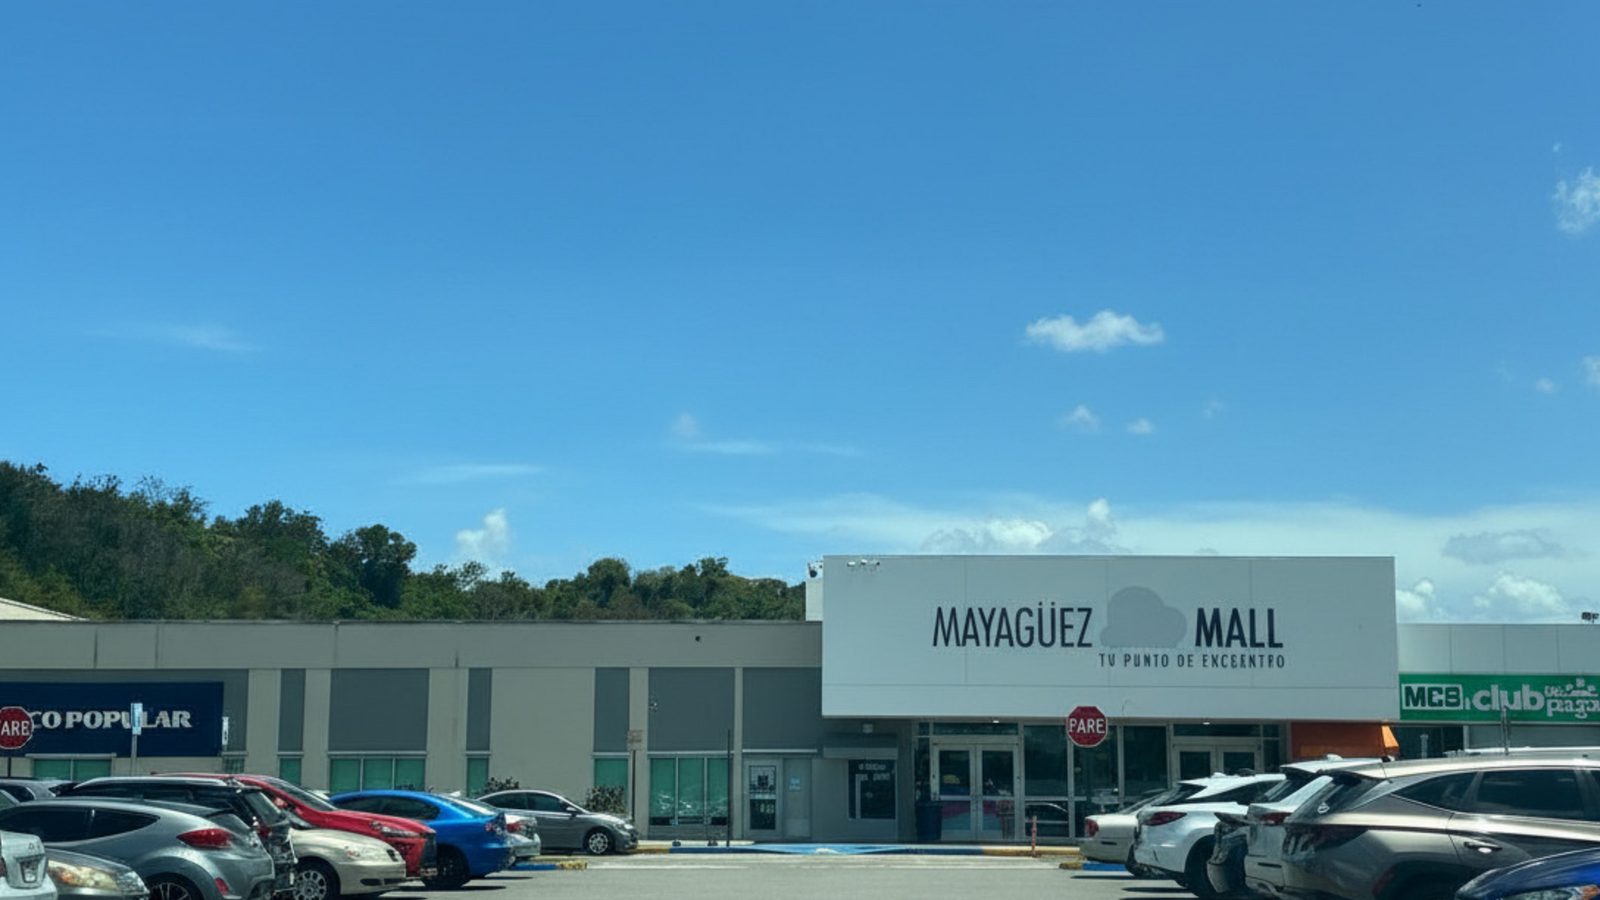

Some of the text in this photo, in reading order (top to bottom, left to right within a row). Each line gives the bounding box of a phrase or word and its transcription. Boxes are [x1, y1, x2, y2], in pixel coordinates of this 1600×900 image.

[932, 601, 1284, 648] MAYAGÜEZ MALL
[1124, 653, 1169, 668] PUNTO
[1472, 684, 1545, 711] club
[0, 720, 30, 736] ARE
[65, 710, 192, 729] POPULAR
[1068, 718, 1105, 734] PARE
